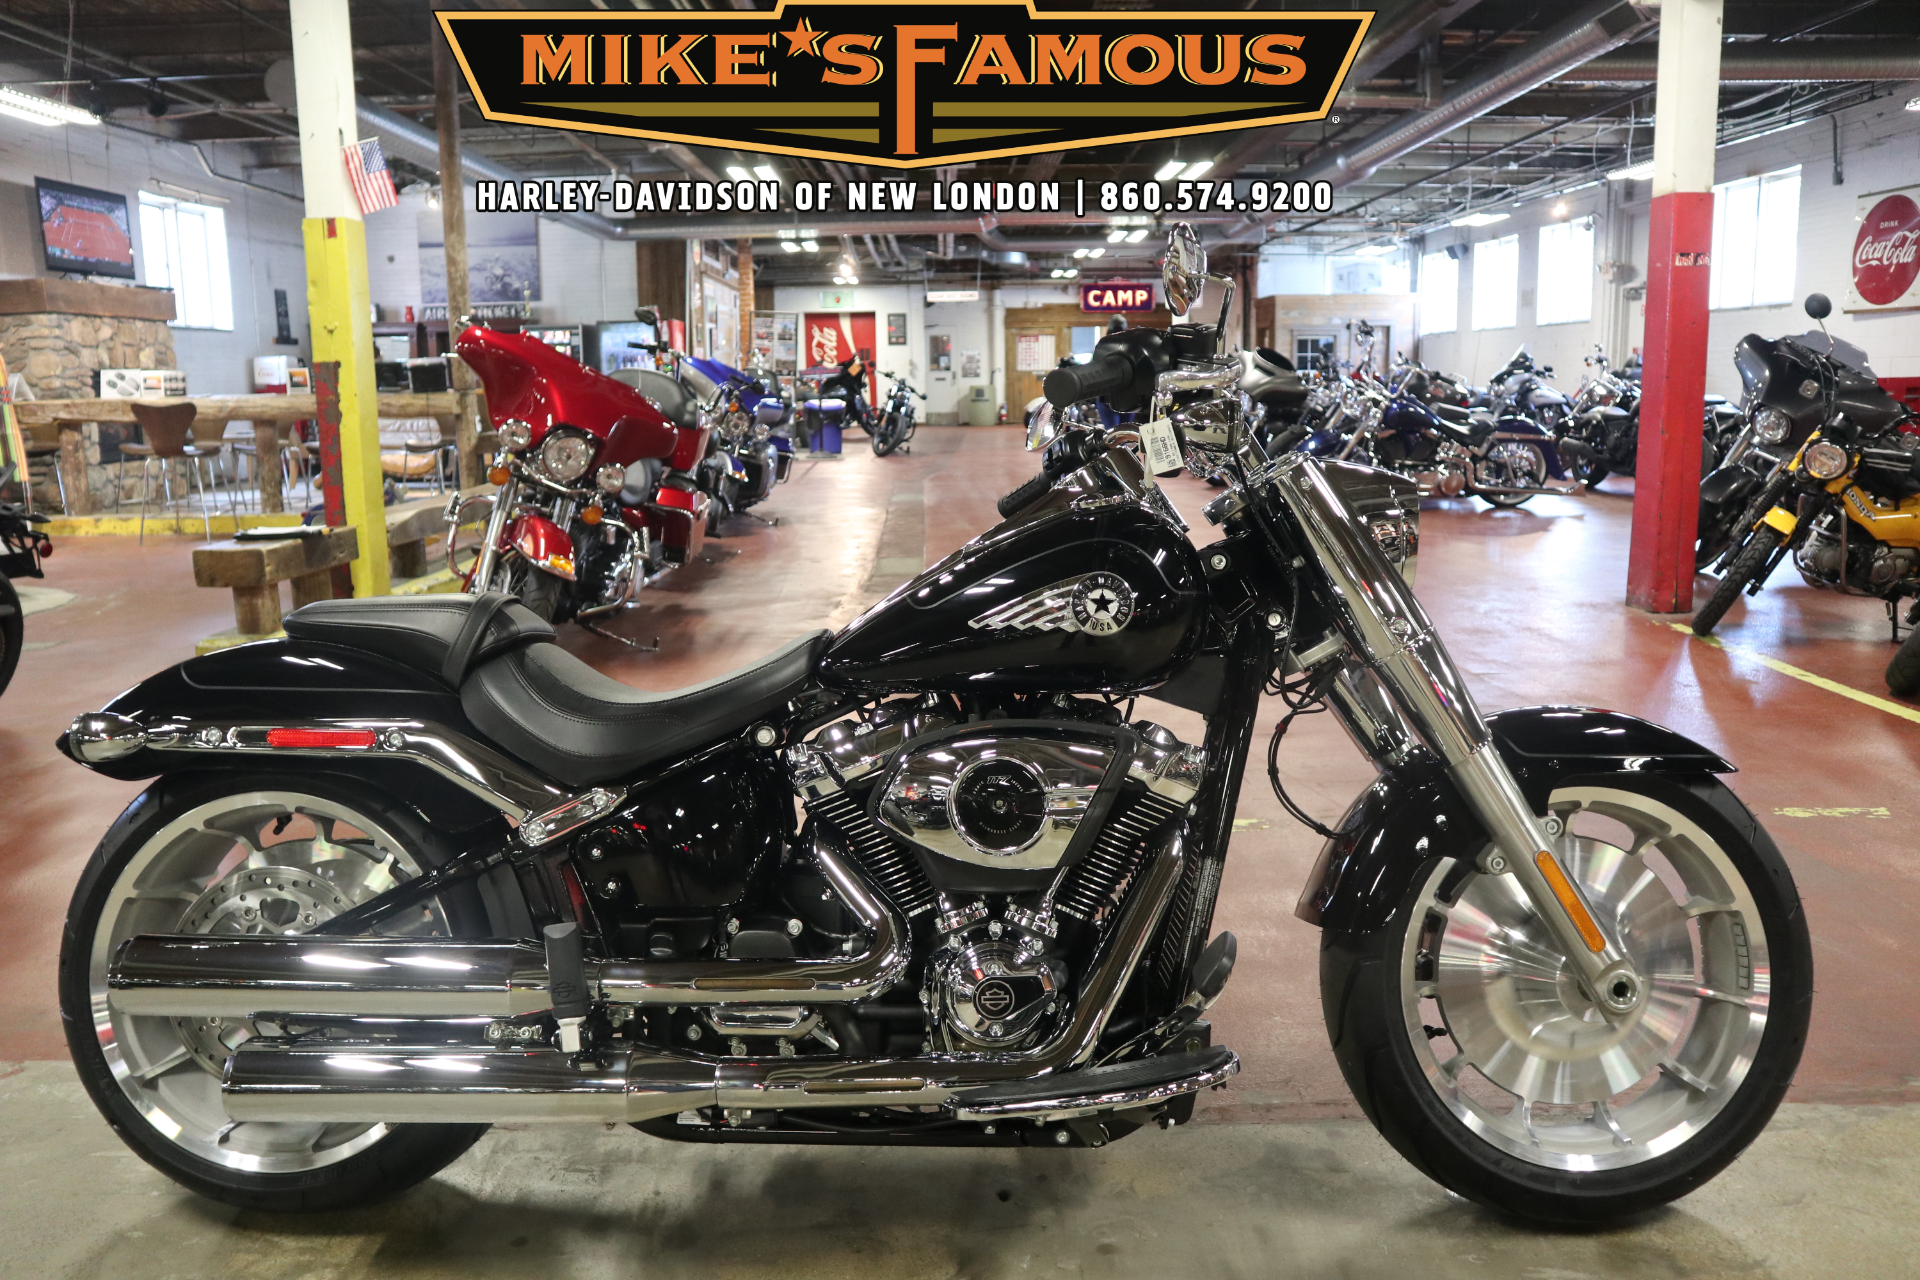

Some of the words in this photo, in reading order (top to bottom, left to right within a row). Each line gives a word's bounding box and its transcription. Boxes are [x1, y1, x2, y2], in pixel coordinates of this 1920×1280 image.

[1880, 220, 1899, 229] DRINK
[1855, 229, 1920, 268] Coca-Cola
[1087, 289, 1149, 308] CAMP
[1091, 621, 1113, 632] USA
